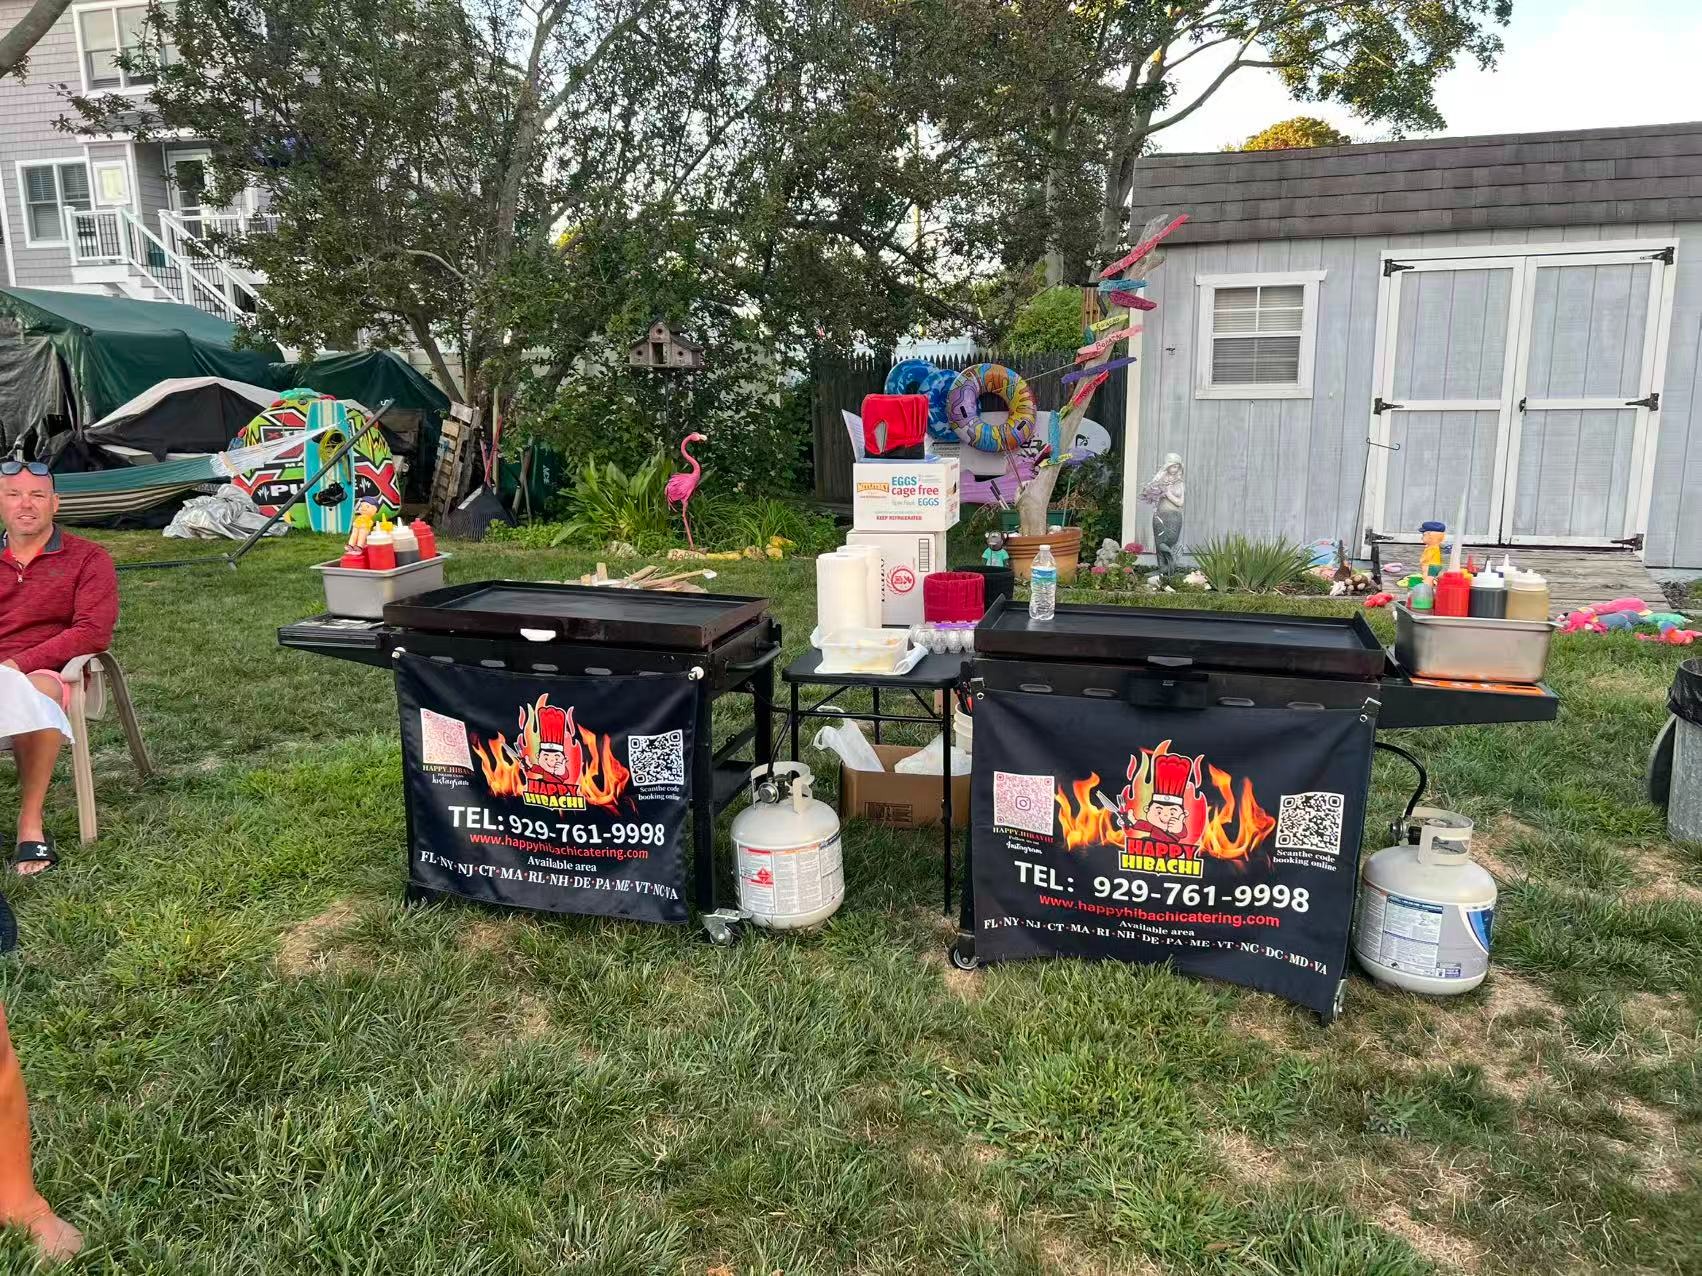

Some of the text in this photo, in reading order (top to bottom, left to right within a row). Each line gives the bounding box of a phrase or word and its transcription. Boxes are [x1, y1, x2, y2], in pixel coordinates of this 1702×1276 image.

[891, 476, 918, 486] EGGS
[891, 487, 916, 498] cage
[918, 484, 939, 496] free
[918, 497, 939, 506] EGGS
[527, 779, 578, 798] HAPPY
[524, 792, 584, 809] HIBACHI
[448, 805, 665, 846] TEL: 929-761-9998
[470, 833, 649, 861] www.happyhibachicatering.com
[1005, 840, 1043, 855] Instagram
[1127, 838, 1197, 860] HAPPY
[527, 856, 597, 873] Available area
[1121, 853, 1201, 875] HIBACHI
[1272, 856, 1337, 872] booking online
[1315, 854, 1336, 864] code
[1014, 860, 1310, 913] TEL: 929-761-9998
[1039, 894, 1281, 928] www.happyhibachicatering.com
[1119, 920, 1195, 937] Available area
